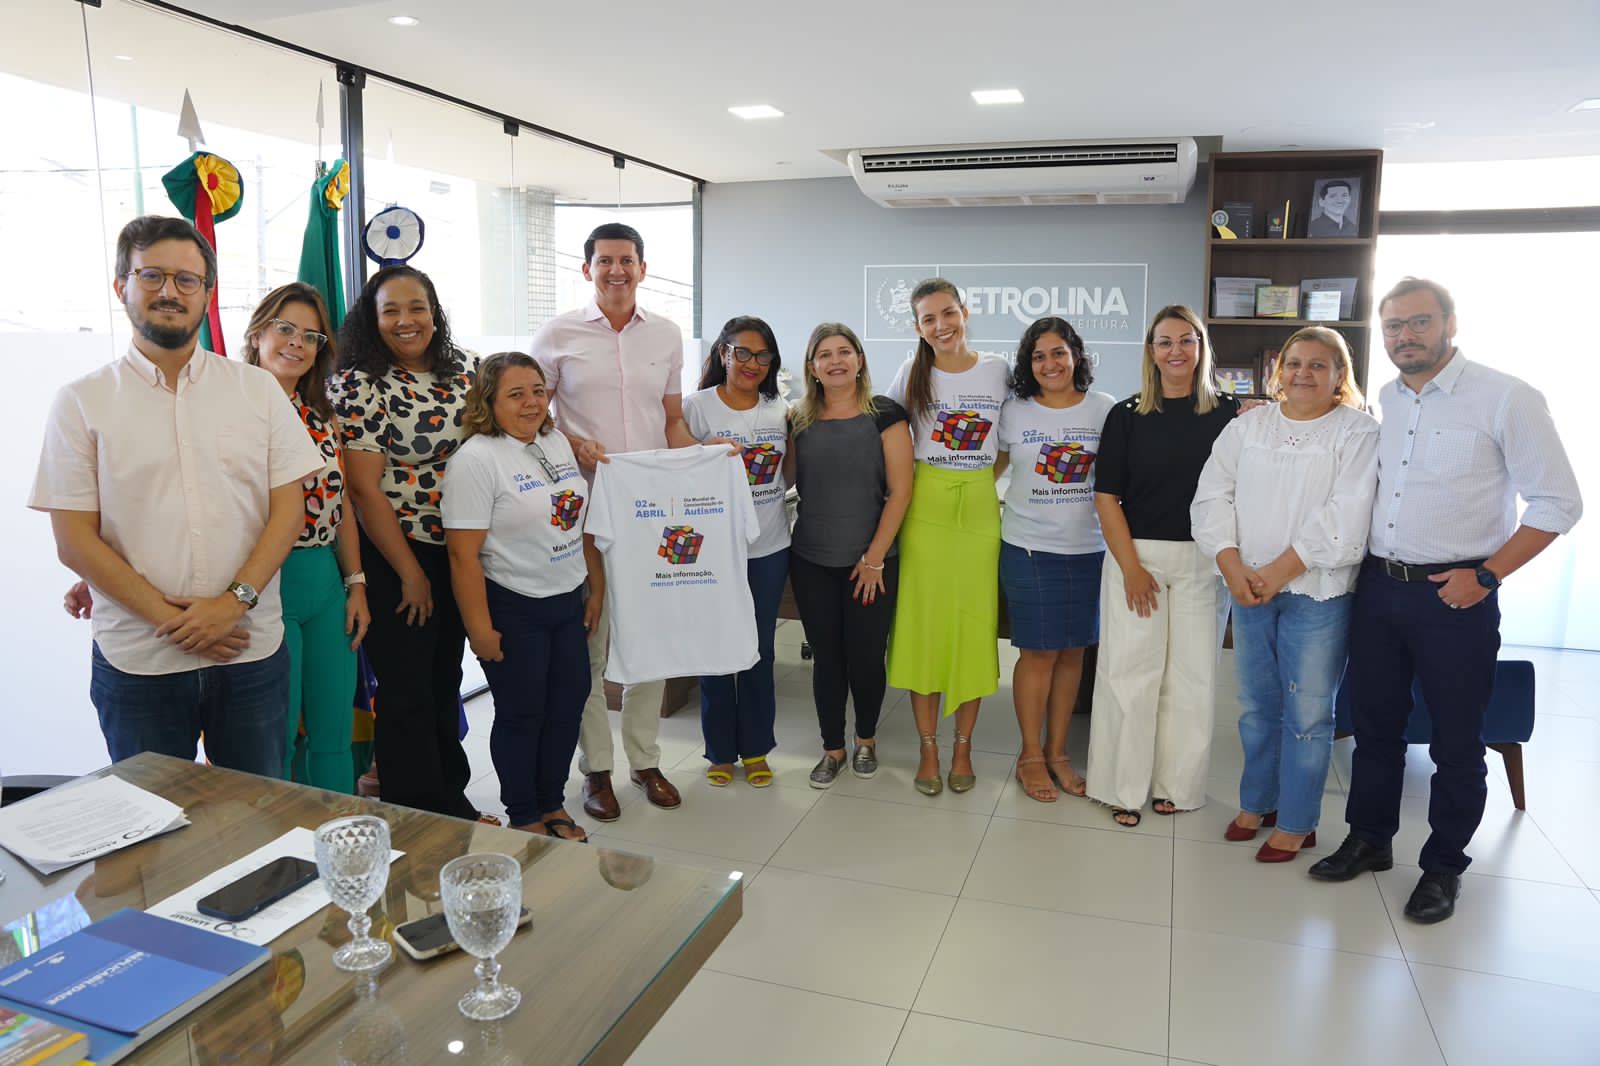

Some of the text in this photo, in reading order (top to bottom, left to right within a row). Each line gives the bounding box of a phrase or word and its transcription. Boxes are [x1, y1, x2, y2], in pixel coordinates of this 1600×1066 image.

[1022, 436, 1055, 444] ABRIL
[519, 480, 545, 493] ABRIL
[1032, 488, 1050, 496] Mais
[635, 500, 648, 508] 02
[635, 510, 667, 518] ABRIL
[684, 507, 724, 516] Autismo
[650, 580, 674, 588] menos
